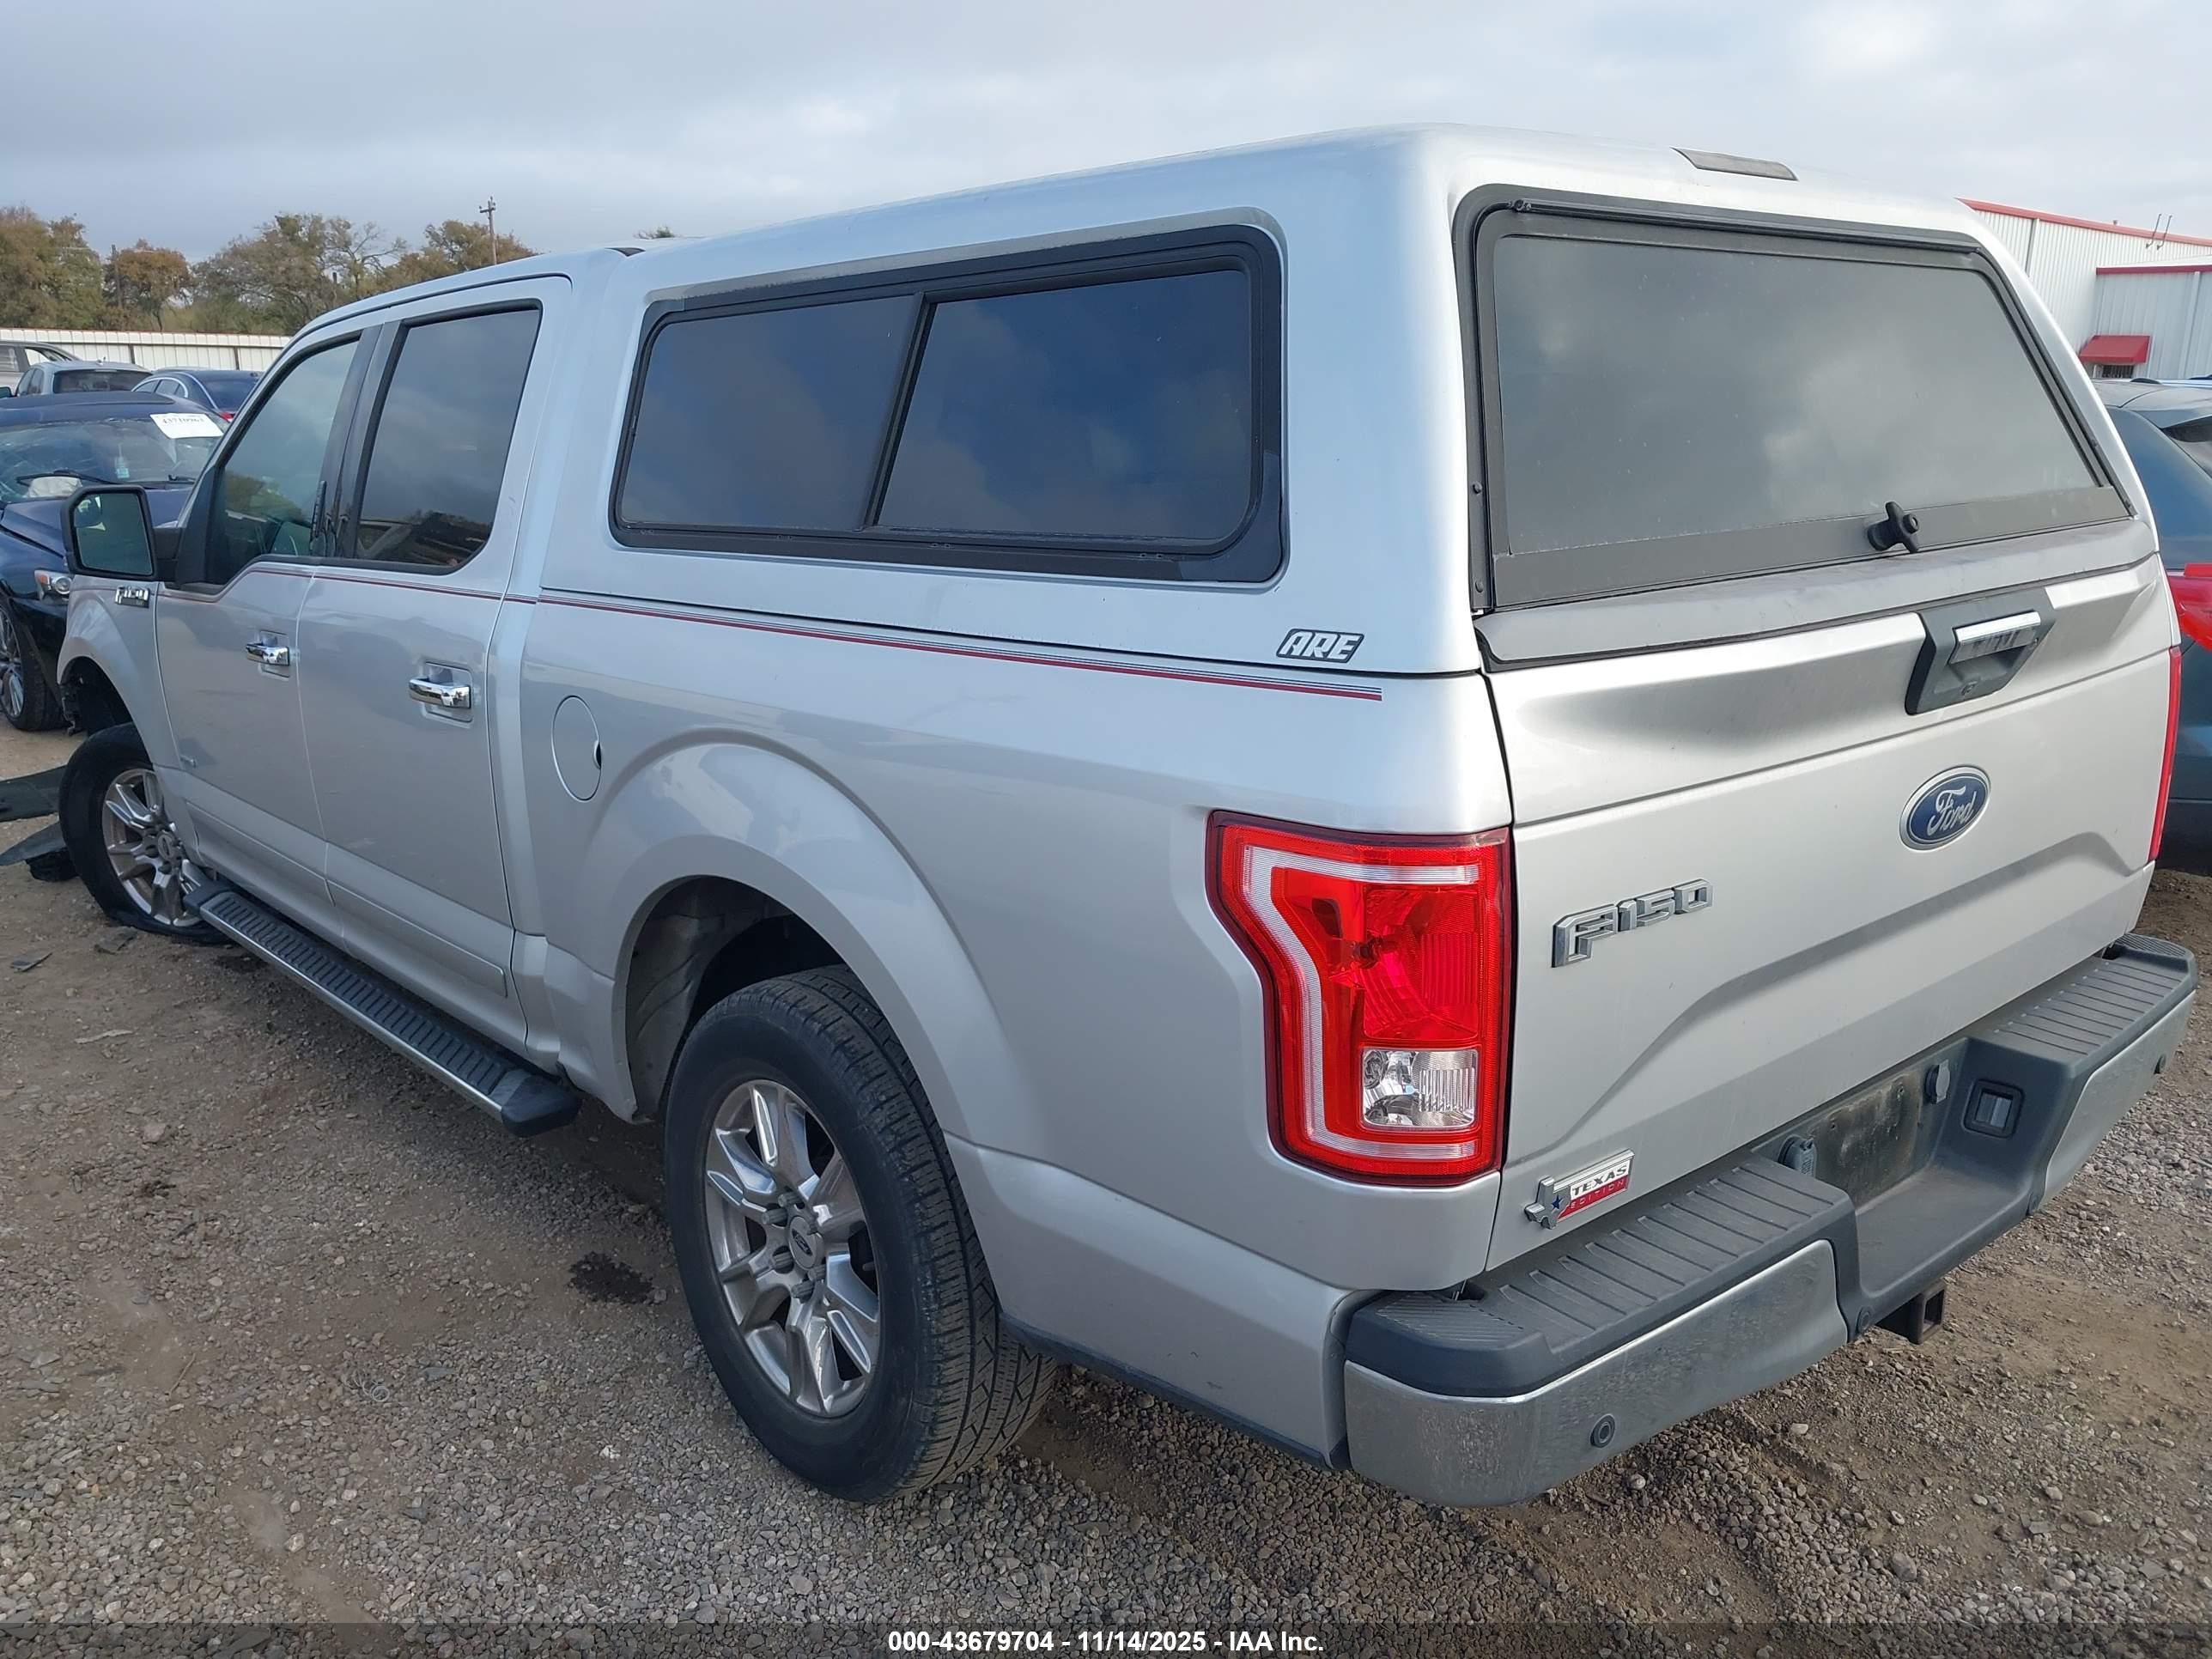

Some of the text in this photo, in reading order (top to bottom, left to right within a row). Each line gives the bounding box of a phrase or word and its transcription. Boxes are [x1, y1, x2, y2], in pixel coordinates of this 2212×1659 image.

[1277, 629, 1363, 662] ARE
[1927, 785, 1977, 836] Ford
[1551, 878, 1713, 968] F150
[1570, 1179, 1625, 1209] EDITION
[1572, 1165, 1627, 1196] TEXAS
